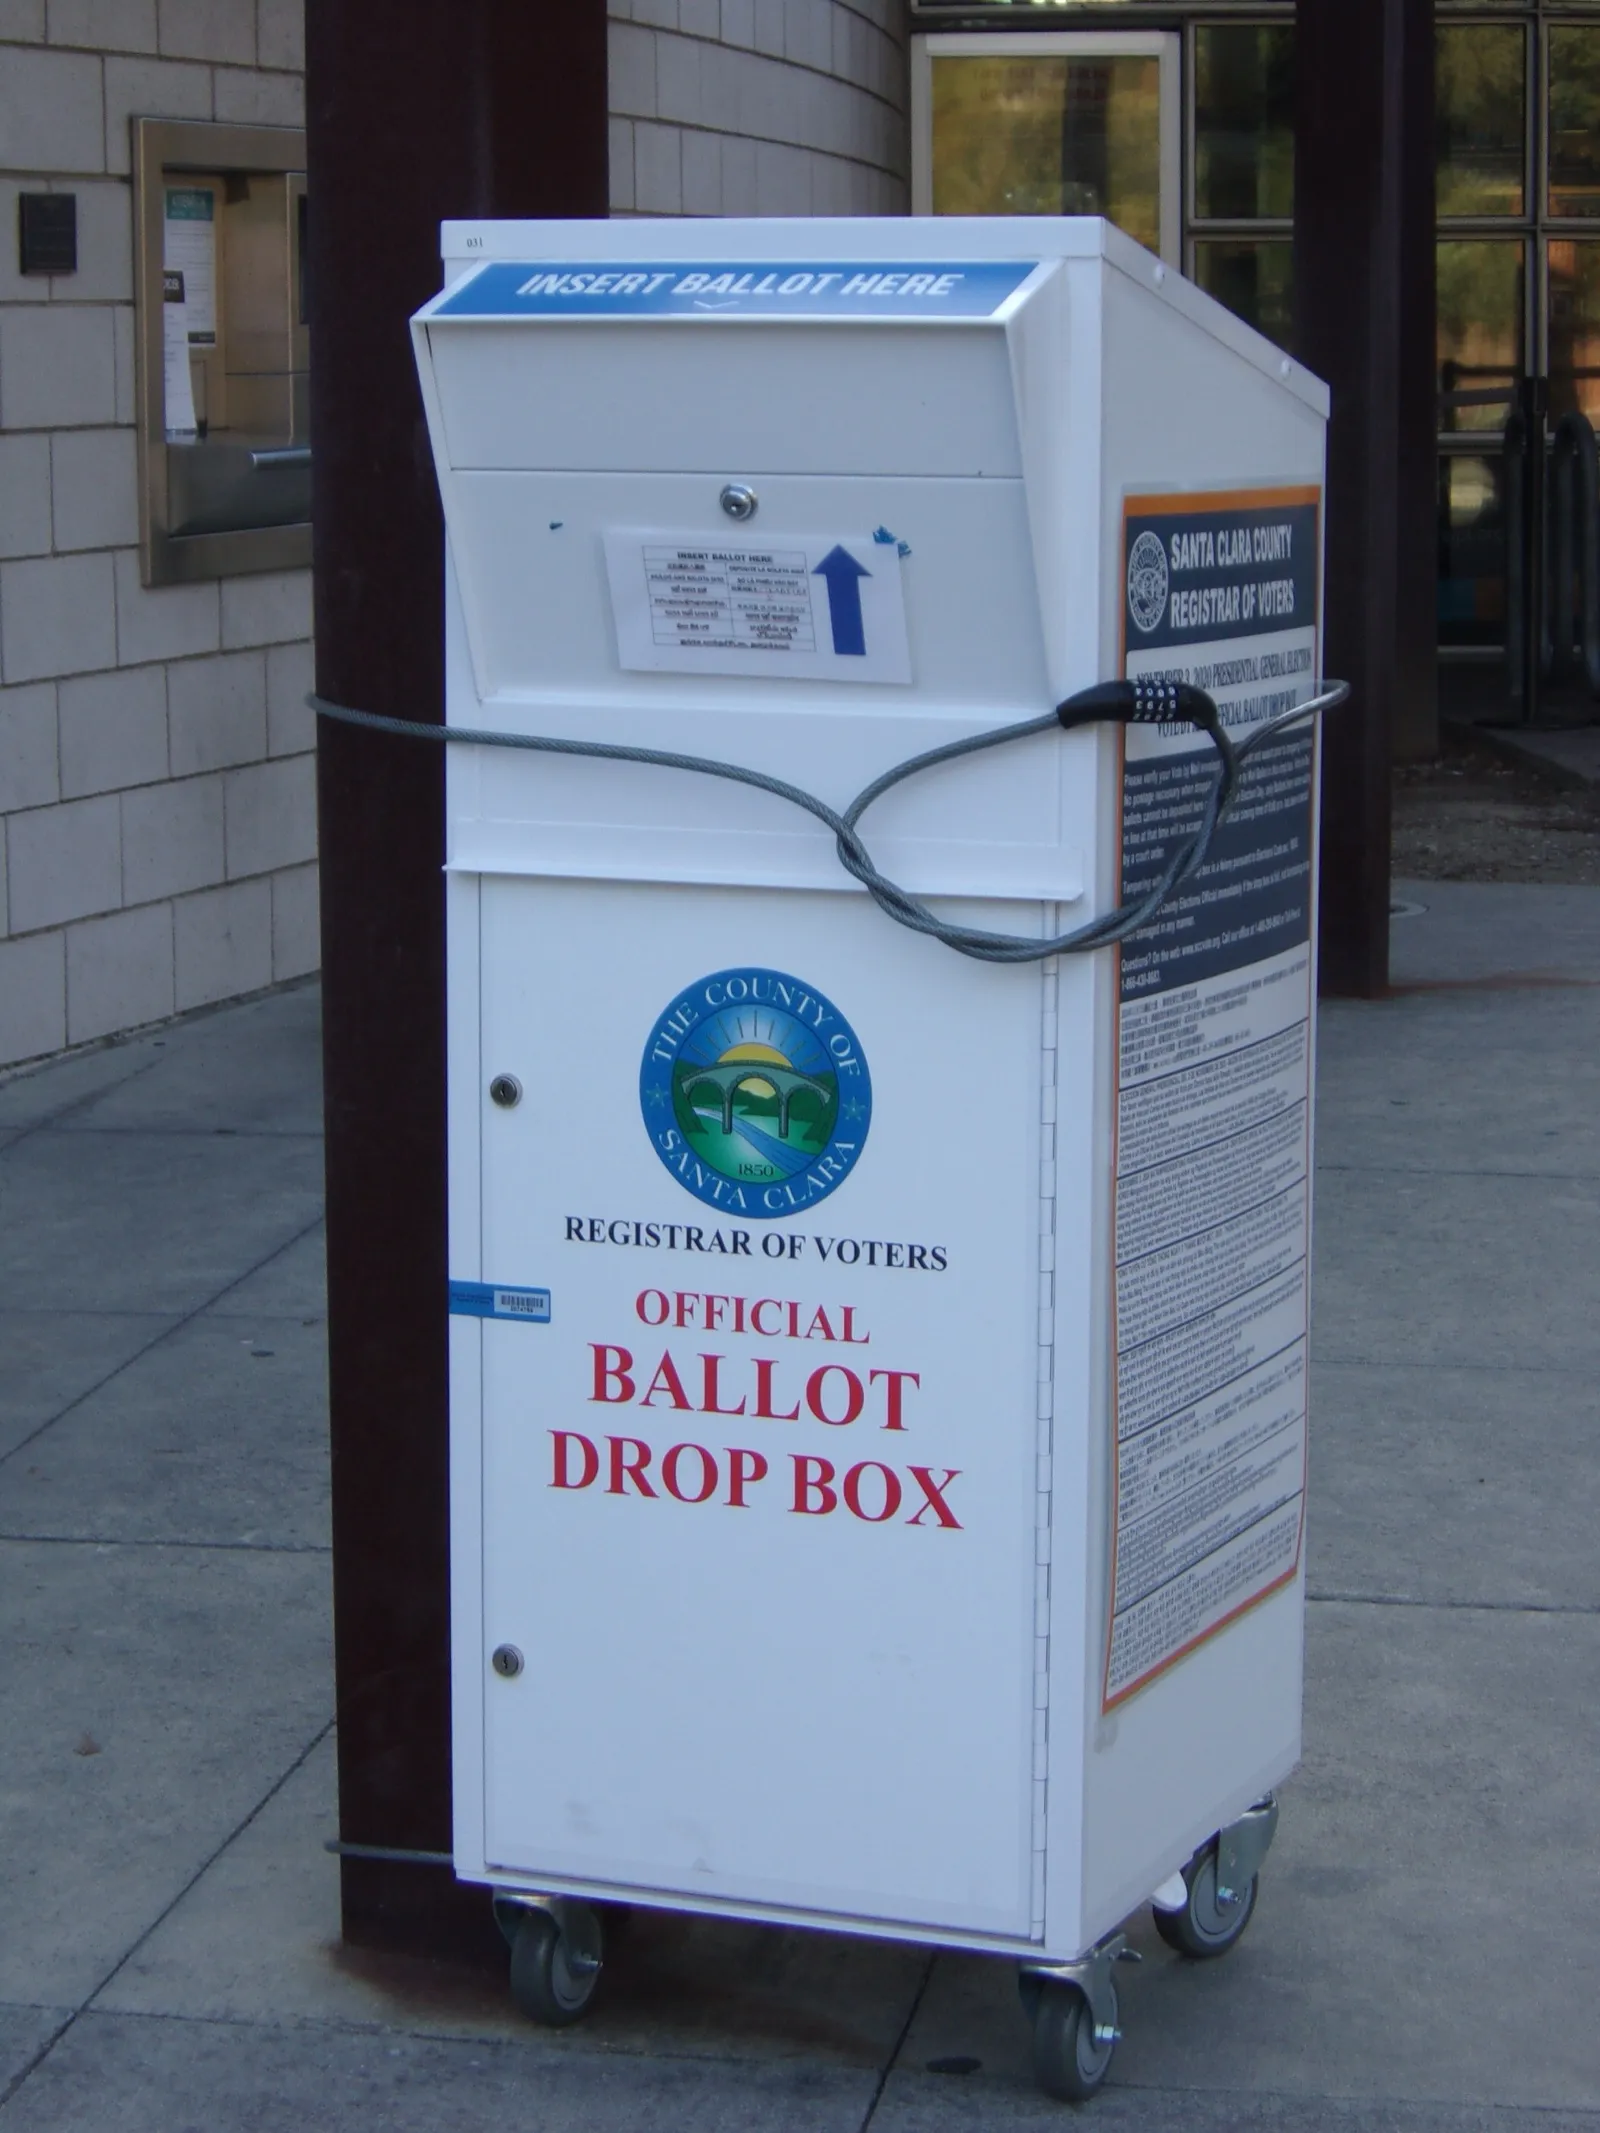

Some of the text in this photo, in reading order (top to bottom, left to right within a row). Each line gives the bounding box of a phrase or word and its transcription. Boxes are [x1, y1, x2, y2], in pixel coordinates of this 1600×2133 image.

[516, 272, 966, 298] INSERT BALLOT HERE
[677, 551, 773, 564] INSERT BALLOT HERE
[1171, 524, 1292, 570] SANTA CLARA COUNTY
[1170, 577, 1295, 629] REGISTRAR OF VOTERS
[1212, 656, 1258, 687] PRESIDENTIAL
[1260, 652, 1286, 680] GENERAL
[1287, 647, 1311, 674] ELECTION
[1217, 700, 1242, 727] FFICIAL
[1244, 695, 1269, 722] BALLOT
[1123, 877, 1151, 896] Tampering
[1161, 903, 1178, 919] County
[1201, 888, 1217, 903] Official
[1121, 951, 1151, 972] Questions?
[1153, 950, 1160, 964] On
[1161, 948, 1169, 961] the
[652, 977, 861, 1077] THE COUNTY OF
[658, 1127, 857, 1210] SANTA CLARA
[737, 1163, 774, 1178] 1850
[564, 1215, 949, 1272] REGISTRAR OF VOTERS
[635, 1288, 871, 1345] OFFICIAL
[586, 1342, 921, 1432] BALLOT
[546, 1428, 965, 1531] DROP BOX
